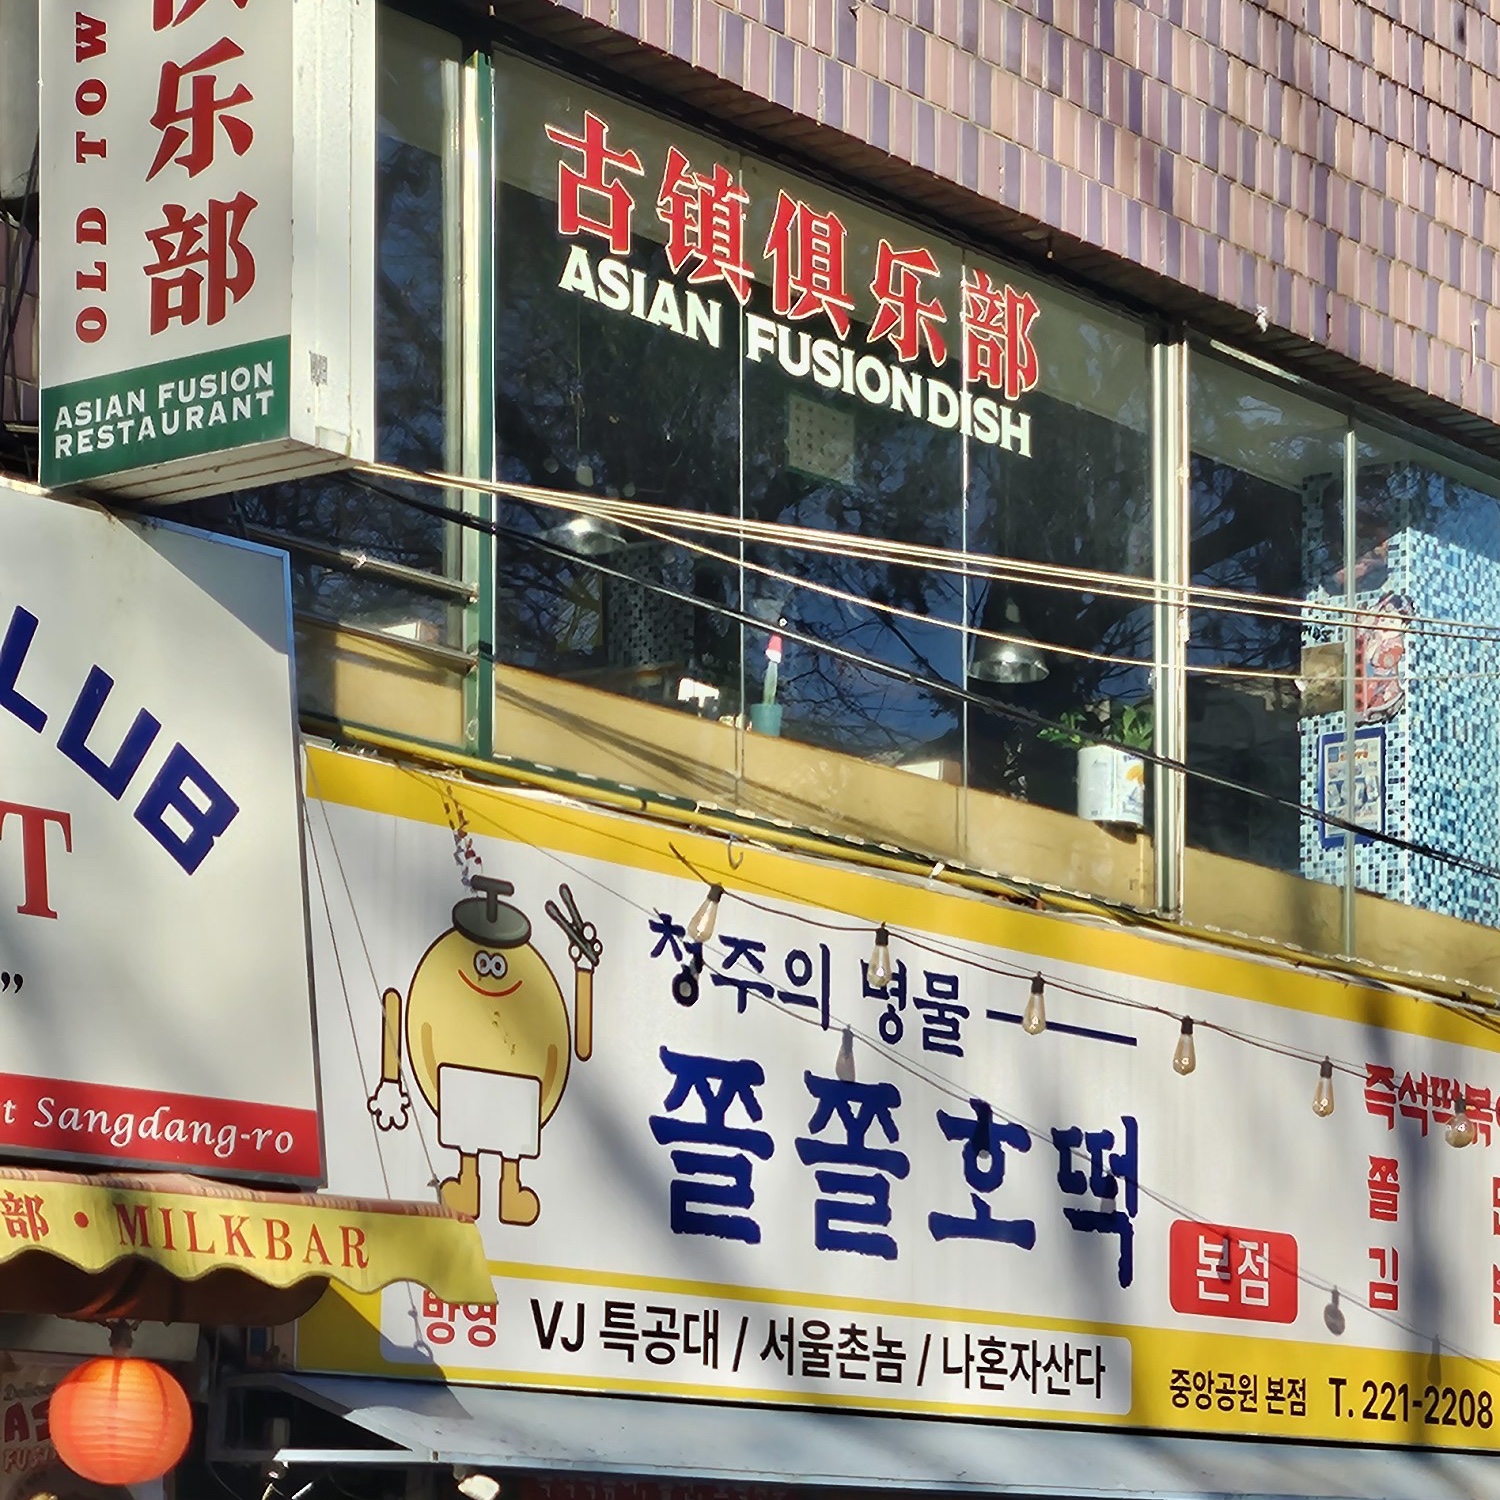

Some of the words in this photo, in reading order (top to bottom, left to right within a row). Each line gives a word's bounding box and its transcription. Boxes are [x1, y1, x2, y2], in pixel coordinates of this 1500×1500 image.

[143, 0, 258, 336] 乐部
[76, 207, 107, 344] OLD
[545, 110, 1041, 400] 古镇俱乐部
[558, 245, 722, 349] ASIAN
[54, 389, 275, 459] RESTAURANT
[55, 390, 146, 431] ASIAN
[157, 360, 274, 411] FUSION
[649, 907, 832, 1031] 청주의
[860, 957, 971, 1057] 명물
[33, 1096, 295, 1159] Sangdang-ro
[648, 1044, 1139, 1290] 쫄쫄호떡
[1, 1194, 50, 1243] 部
[115, 1202, 370, 1271] MILKBAR
[1195, 1234, 1271, 1307] 본점
[530, 1298, 586, 1353] VJ
[599, 1301, 720, 1370] 특공대
[760, 1316, 907, 1385] 서울촌놈
[942, 1333, 1106, 1399] 나혼자산다
[1168, 1369, 1259, 1413] 중앙공원
[1264, 1376, 1308, 1417] 본점
